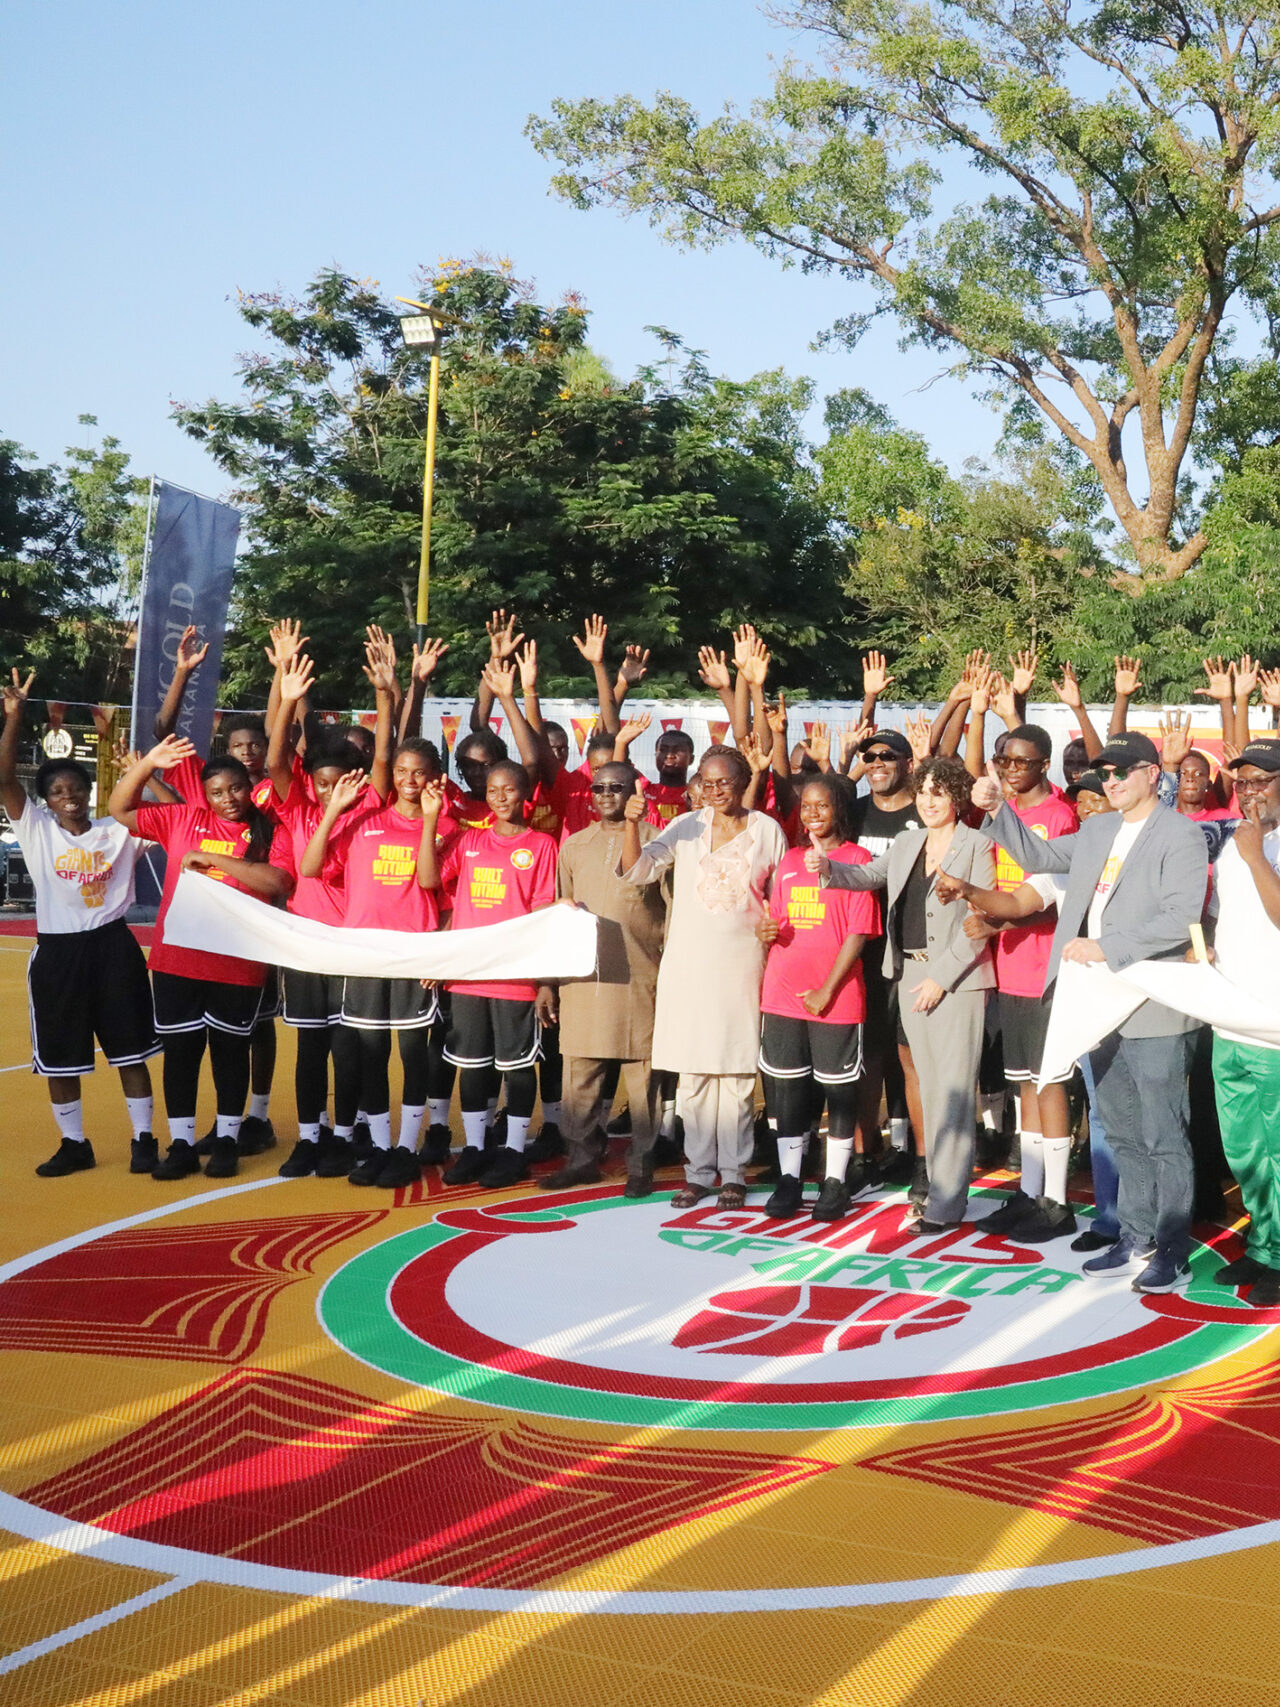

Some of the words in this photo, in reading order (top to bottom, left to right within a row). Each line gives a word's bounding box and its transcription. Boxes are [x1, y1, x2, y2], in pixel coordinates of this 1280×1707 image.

[56, 870, 78, 881] OF
[658, 1229, 796, 1257] OF
[749, 1247, 1085, 1299] AFRICA
